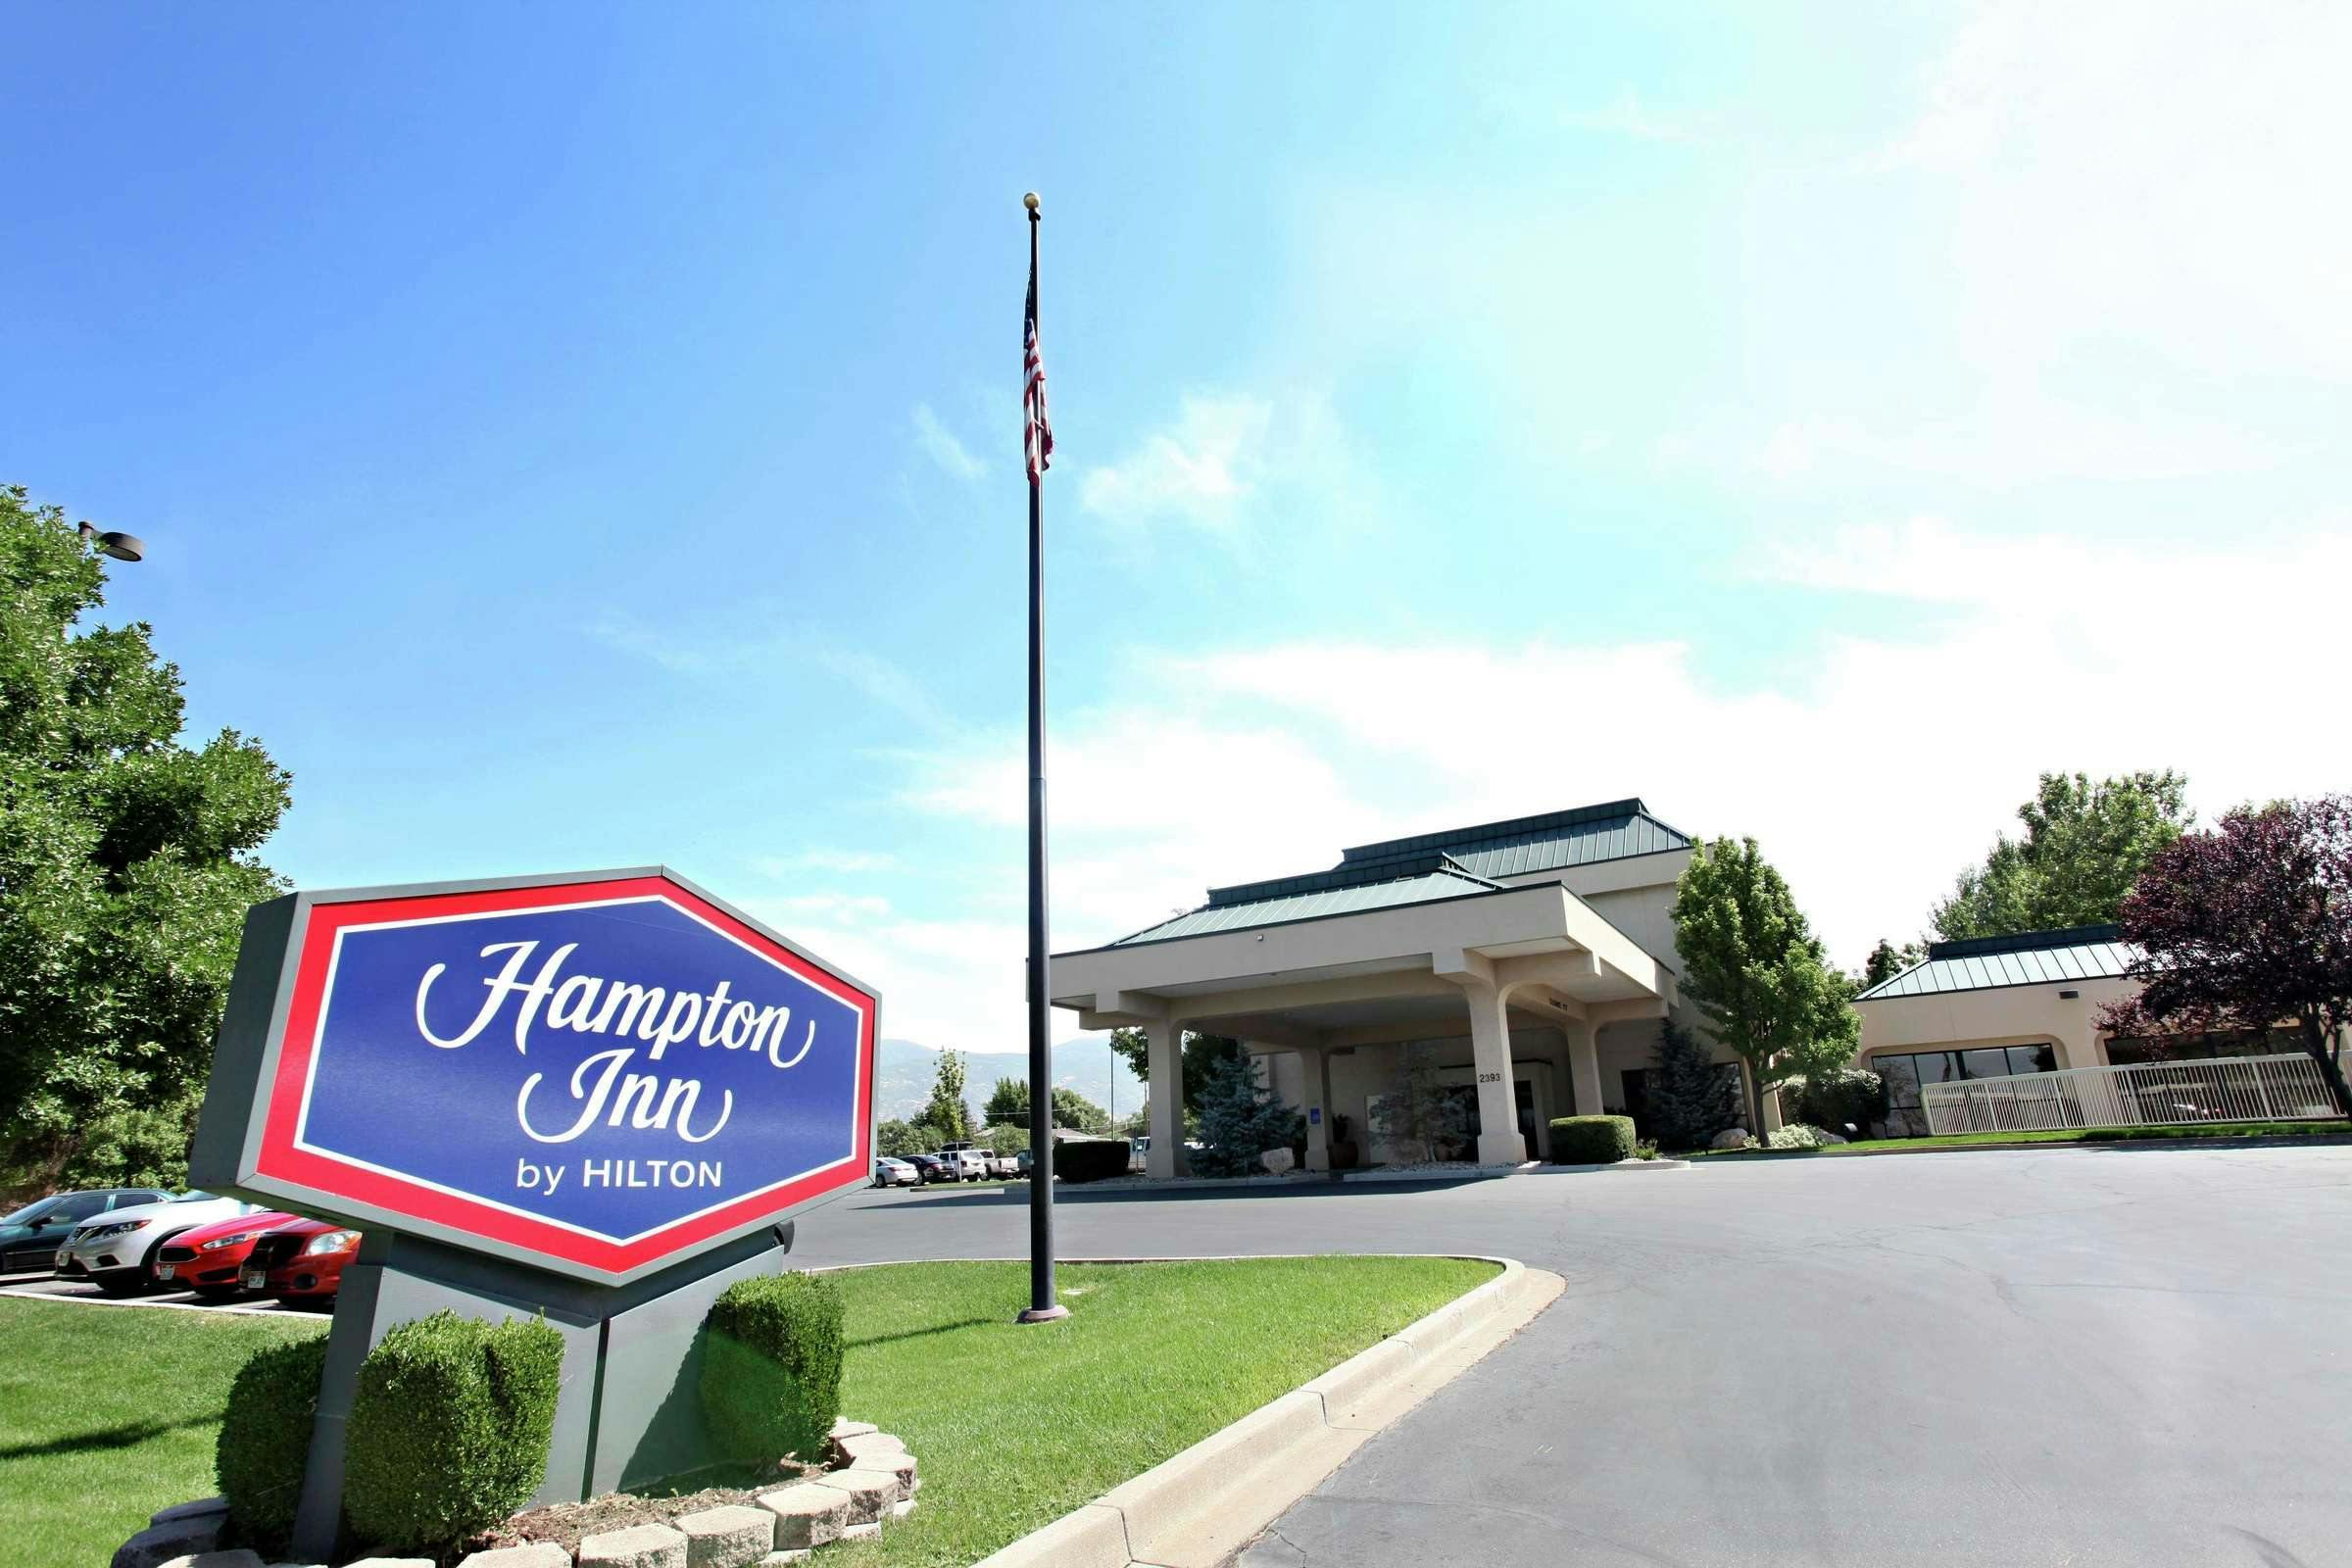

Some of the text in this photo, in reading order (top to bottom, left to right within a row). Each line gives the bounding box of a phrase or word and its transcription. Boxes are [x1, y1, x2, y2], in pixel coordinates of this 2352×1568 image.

[416, 940, 815, 1068] Hampton
[516, 1048, 733, 1144] Inn
[1479, 1073, 1501, 1083] 2393
[516, 1157, 722, 1196] by HILTON
